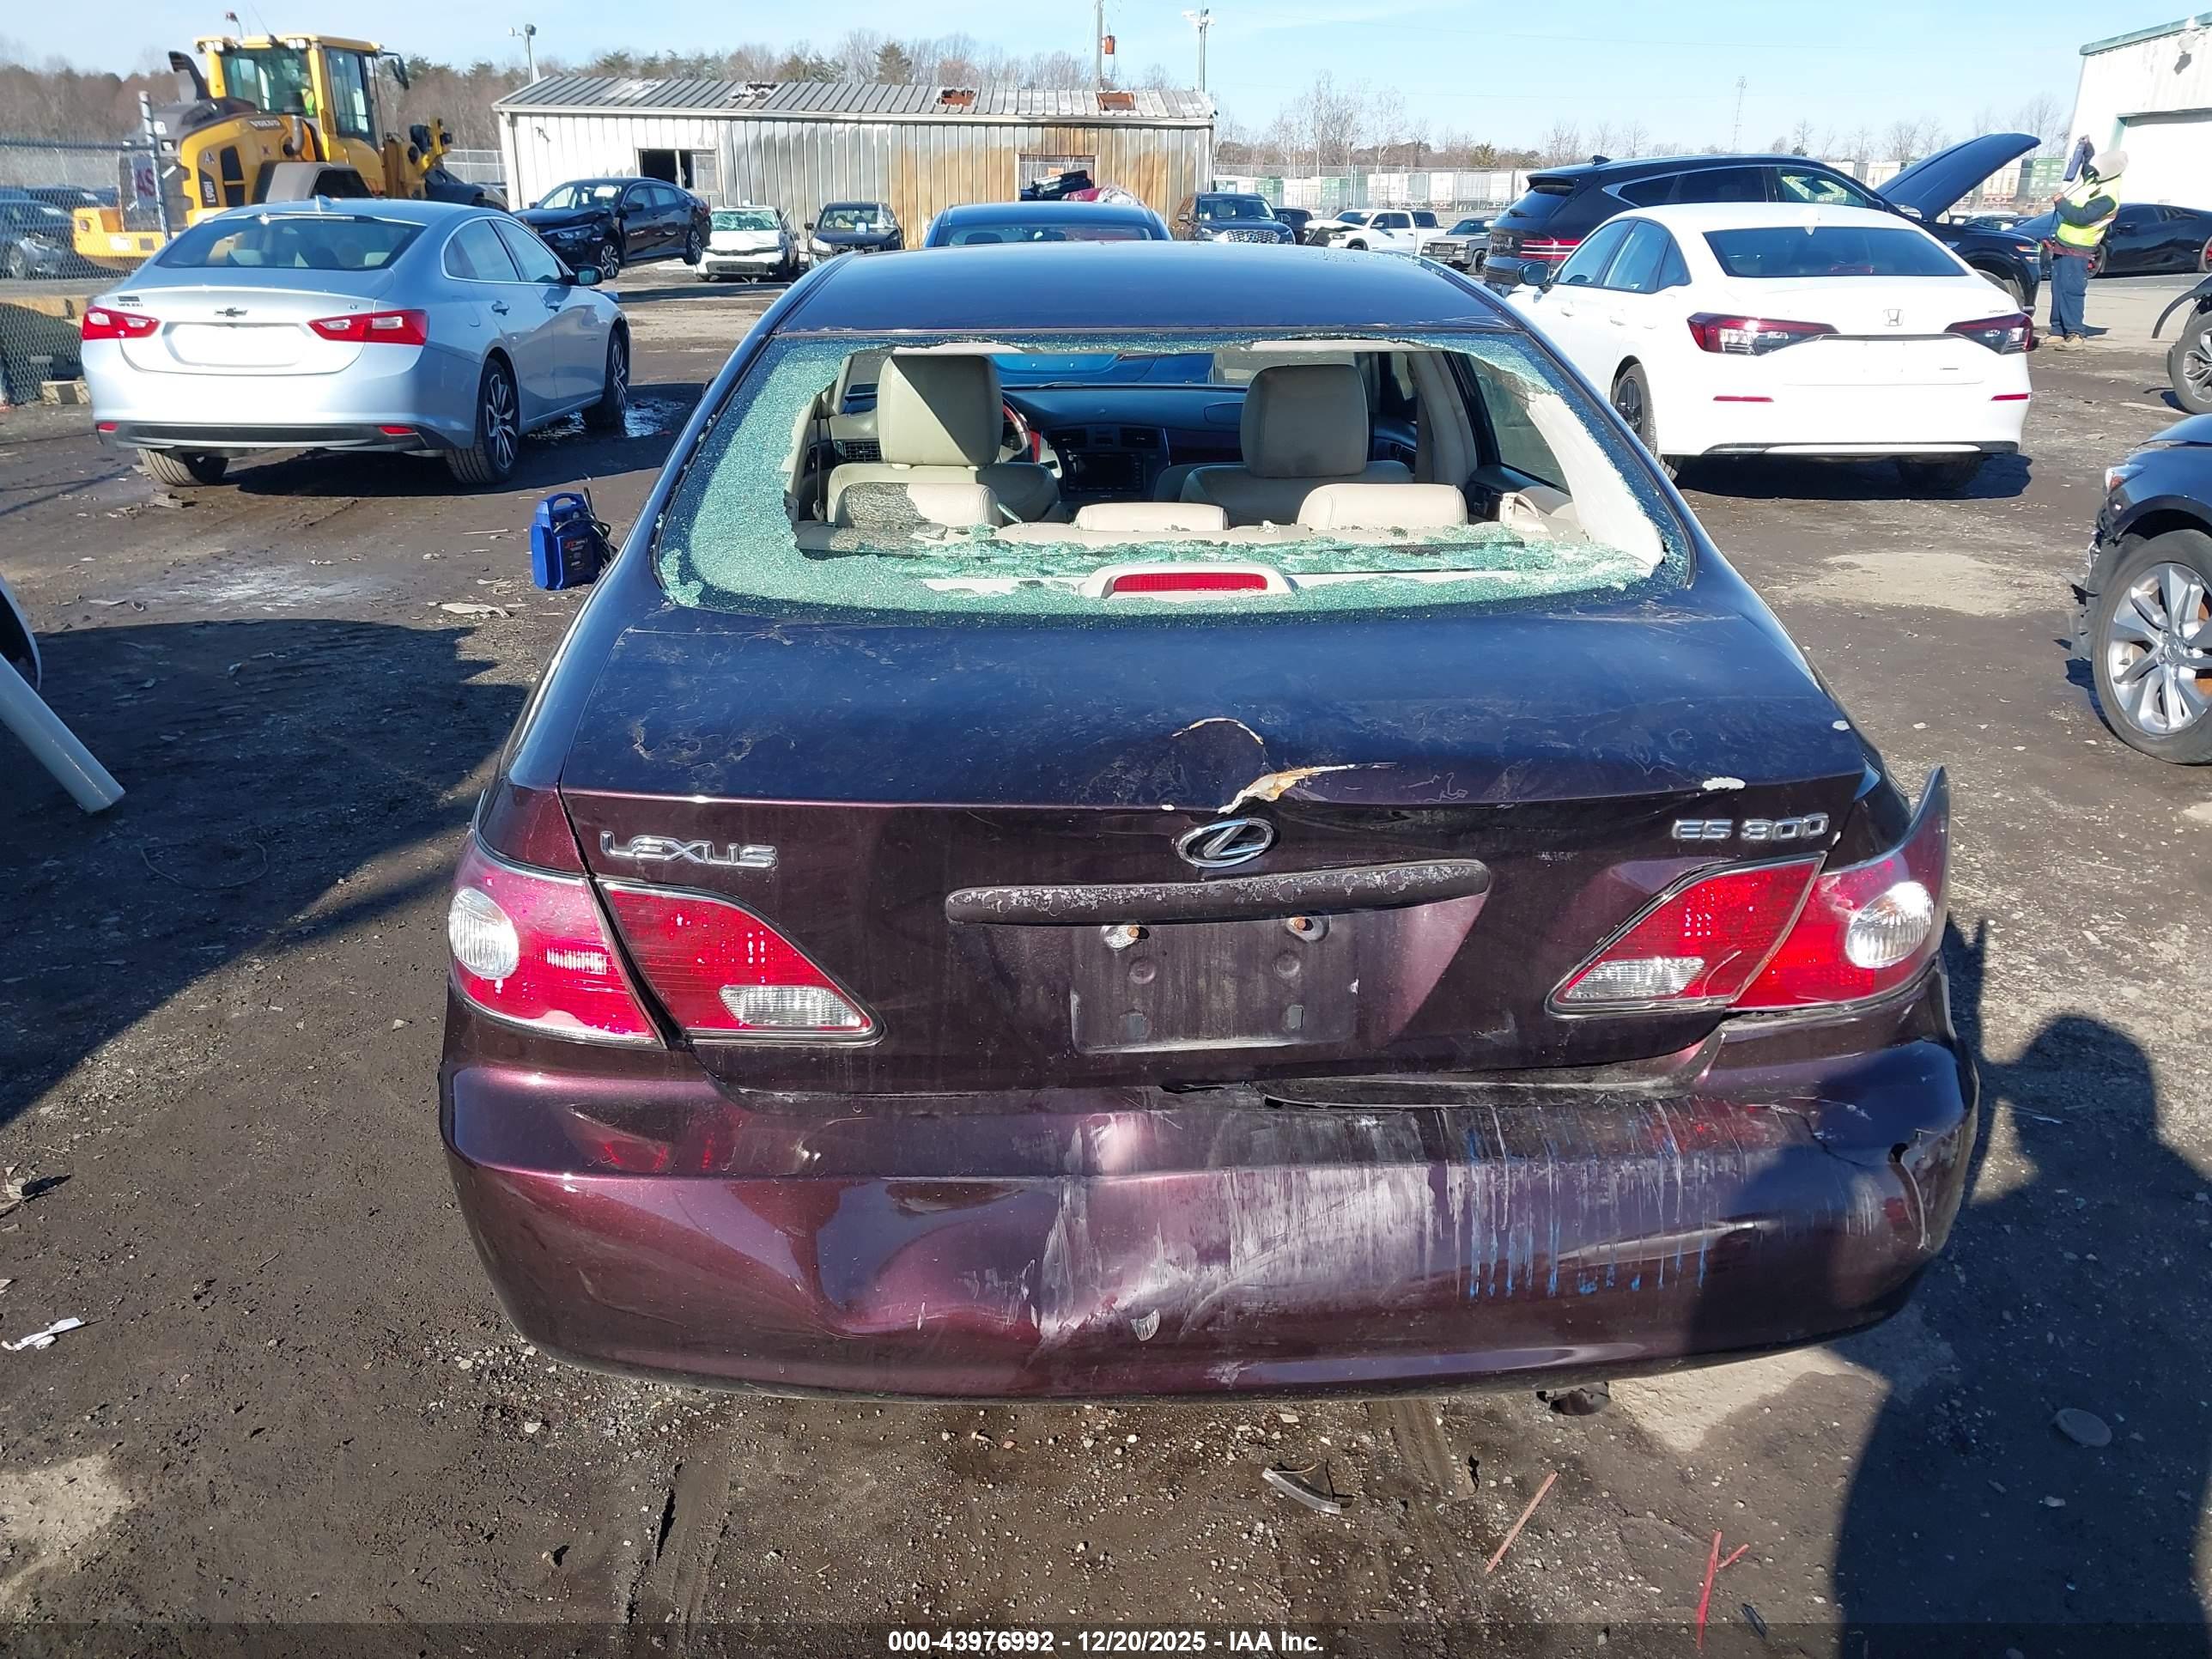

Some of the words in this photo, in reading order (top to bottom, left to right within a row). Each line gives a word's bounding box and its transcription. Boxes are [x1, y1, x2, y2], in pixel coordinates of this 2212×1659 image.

[1672, 818, 1734, 840] ES
[1740, 812, 1830, 841] 300
[600, 830, 779, 869] LEXUS
